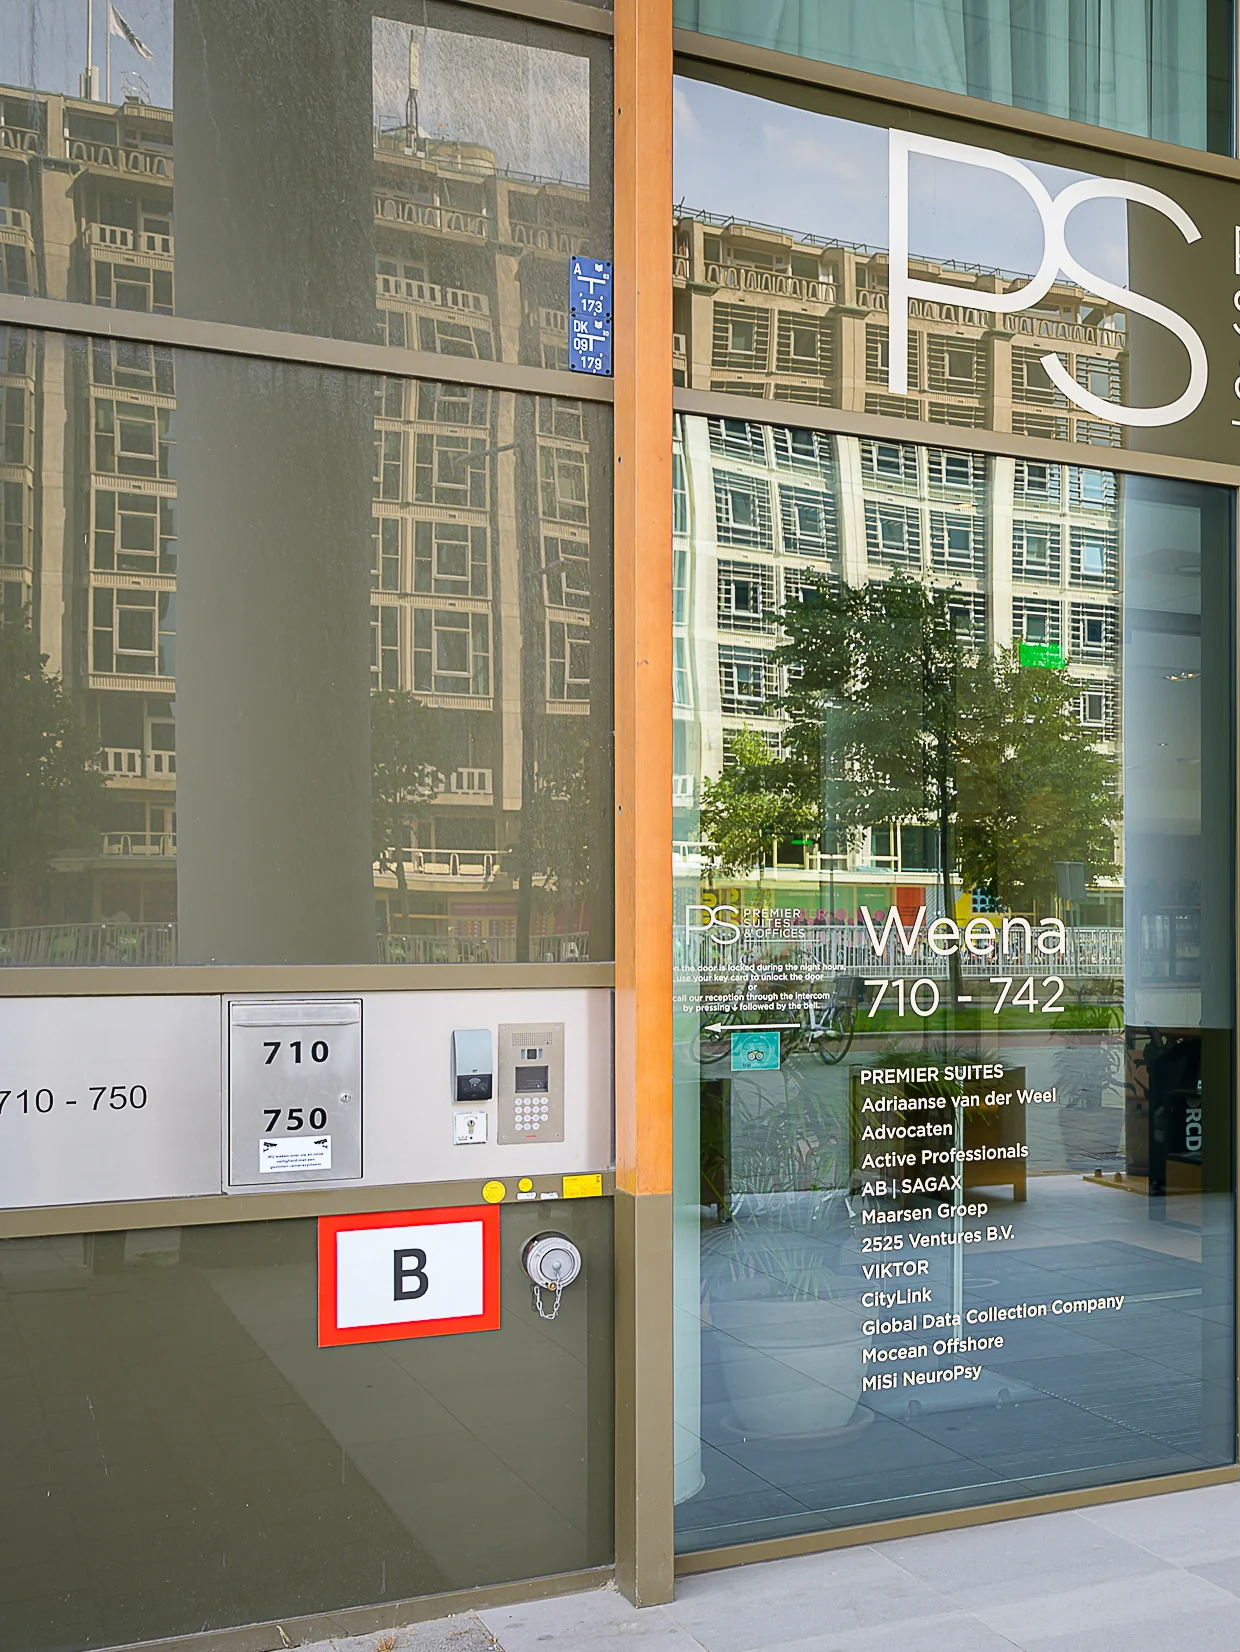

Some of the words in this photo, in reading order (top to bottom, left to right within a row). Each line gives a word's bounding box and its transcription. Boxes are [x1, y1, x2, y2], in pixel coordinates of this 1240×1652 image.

[574, 262, 582, 275] A
[888, 128, 1209, 427] PS
[574, 320, 588, 333] DK
[574, 338, 588, 351] 09
[744, 909, 800, 918] PREMIER
[744, 919, 790, 928] SUITES
[686, 905, 740, 945] PS
[744, 929, 751, 938] &
[756, 929, 805, 938] OFFICES
[860, 904, 1067, 957] Weena
[714, 974, 728, 982] key
[757, 963, 783, 972] during
[800, 963, 820, 971] night
[683, 1004, 693, 1012] by
[696, 1004, 730, 1012] pressing
[740, 1002, 774, 1010] followed
[777, 1003, 786, 1011] by
[705, 993, 744, 1002] reception
[746, 992, 778, 1001] through
[864, 978, 940, 1018] 710
[990, 976, 1065, 1015] 742
[263, 1040, 330, 1065] 710
[860, 1068, 938, 1085] PREMIER
[944, 1064, 1004, 1081] SUITES
[0, 1089, 53, 1114] 710
[89, 1085, 146, 1110] 750
[862, 1096, 946, 1113] Adriaanse
[951, 1094, 980, 1108] van
[985, 1090, 1012, 1106] der
[1016, 1088, 1056, 1104] Weel
[264, 1108, 328, 1132] 750
[862, 1122, 952, 1141] Advocaten
[862, 1150, 916, 1169] Active
[921, 1142, 1029, 1164] Professionals
[862, 1181, 887, 1197] AB
[901, 1175, 962, 1194] SAGAX
[862, 1208, 932, 1225] Maarsen
[937, 1202, 988, 1221] Groep
[862, 1235, 903, 1253] 2525
[909, 1229, 982, 1249] Ventures
[987, 1225, 1015, 1241] B.V.
[393, 1248, 429, 1301] B
[862, 1260, 929, 1280] VIKTOR
[862, 1287, 932, 1308] CityLink
[862, 1316, 917, 1336] Global
[922, 1312, 961, 1329] Data
[966, 1302, 1047, 1325] Collection
[1051, 1295, 1124, 1316] Company
[862, 1345, 928, 1364] Mocean
[932, 1335, 1004, 1356] Offshore
[862, 1373, 898, 1391] MiSi
[903, 1364, 982, 1388] NeuroPsy
